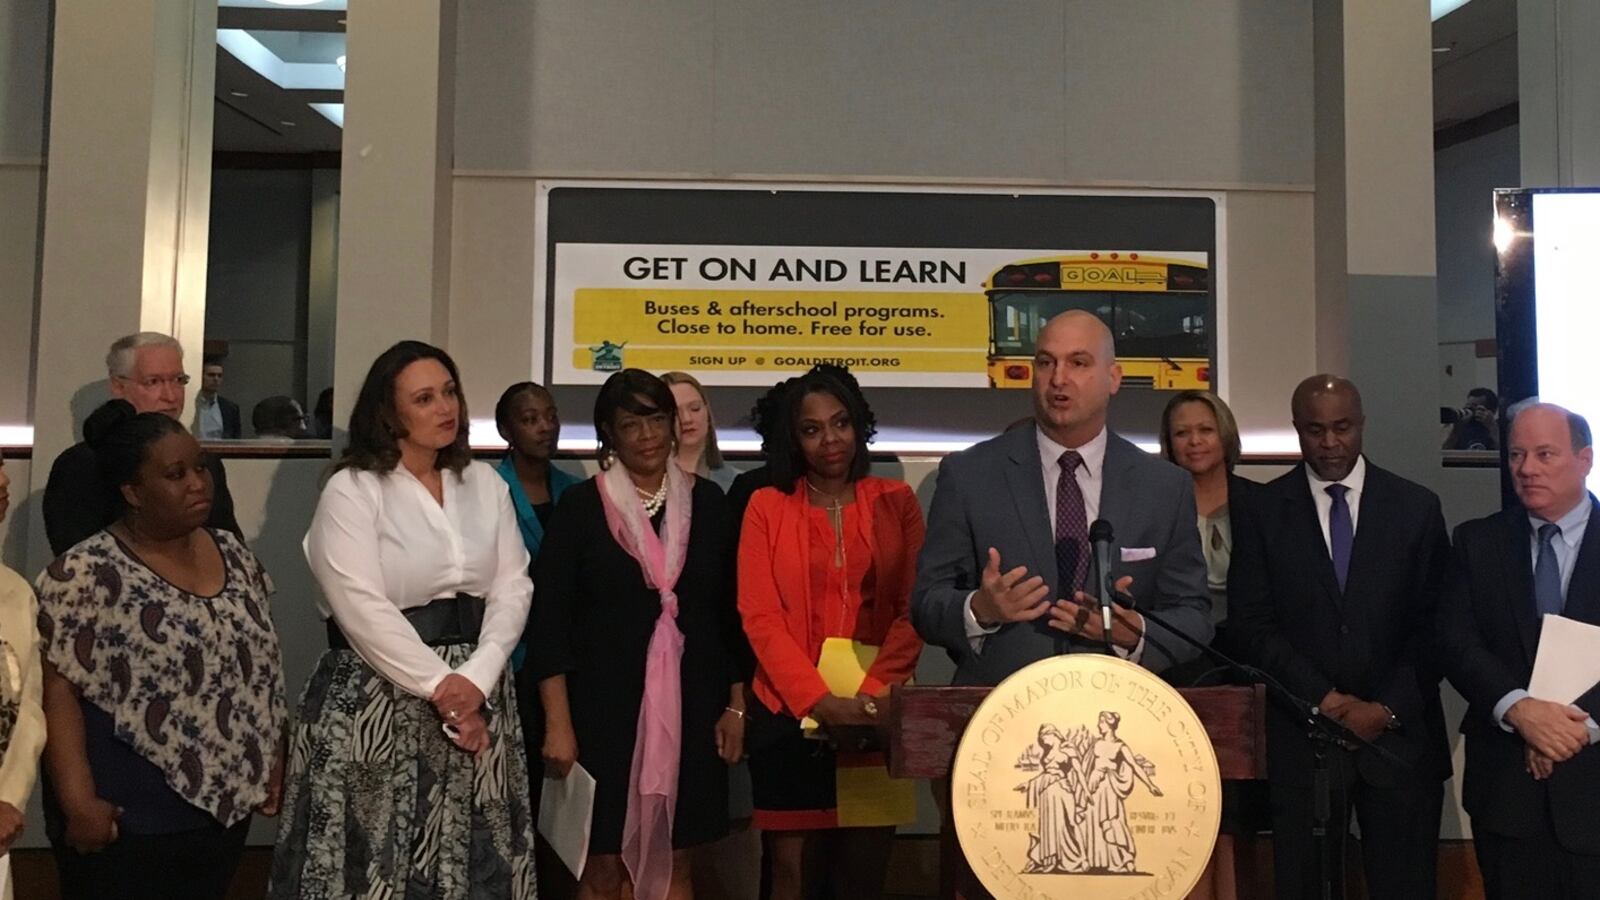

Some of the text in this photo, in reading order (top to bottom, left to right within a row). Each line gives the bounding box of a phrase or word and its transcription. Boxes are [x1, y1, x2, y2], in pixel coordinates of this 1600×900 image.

[623, 256, 967, 285] GET ON AND LEARN
[1065, 269, 1136, 282] GOAL
[644, 301, 945, 320] Buses & afterschool programs.
[657, 319, 932, 336] Close to home. Free for use.
[689, 356, 723, 365] SIGN
[728, 357, 747, 366] UP
[773, 356, 901, 367] GOALDETROIT.ORG
[967, 751, 992, 809] SEAL
[980, 712, 1008, 747] OF
[1002, 670, 1084, 719] MAYOR
[1090, 670, 1121, 694] OF
[1126, 680, 1173, 722] THE
[1186, 781, 1208, 815] OF
